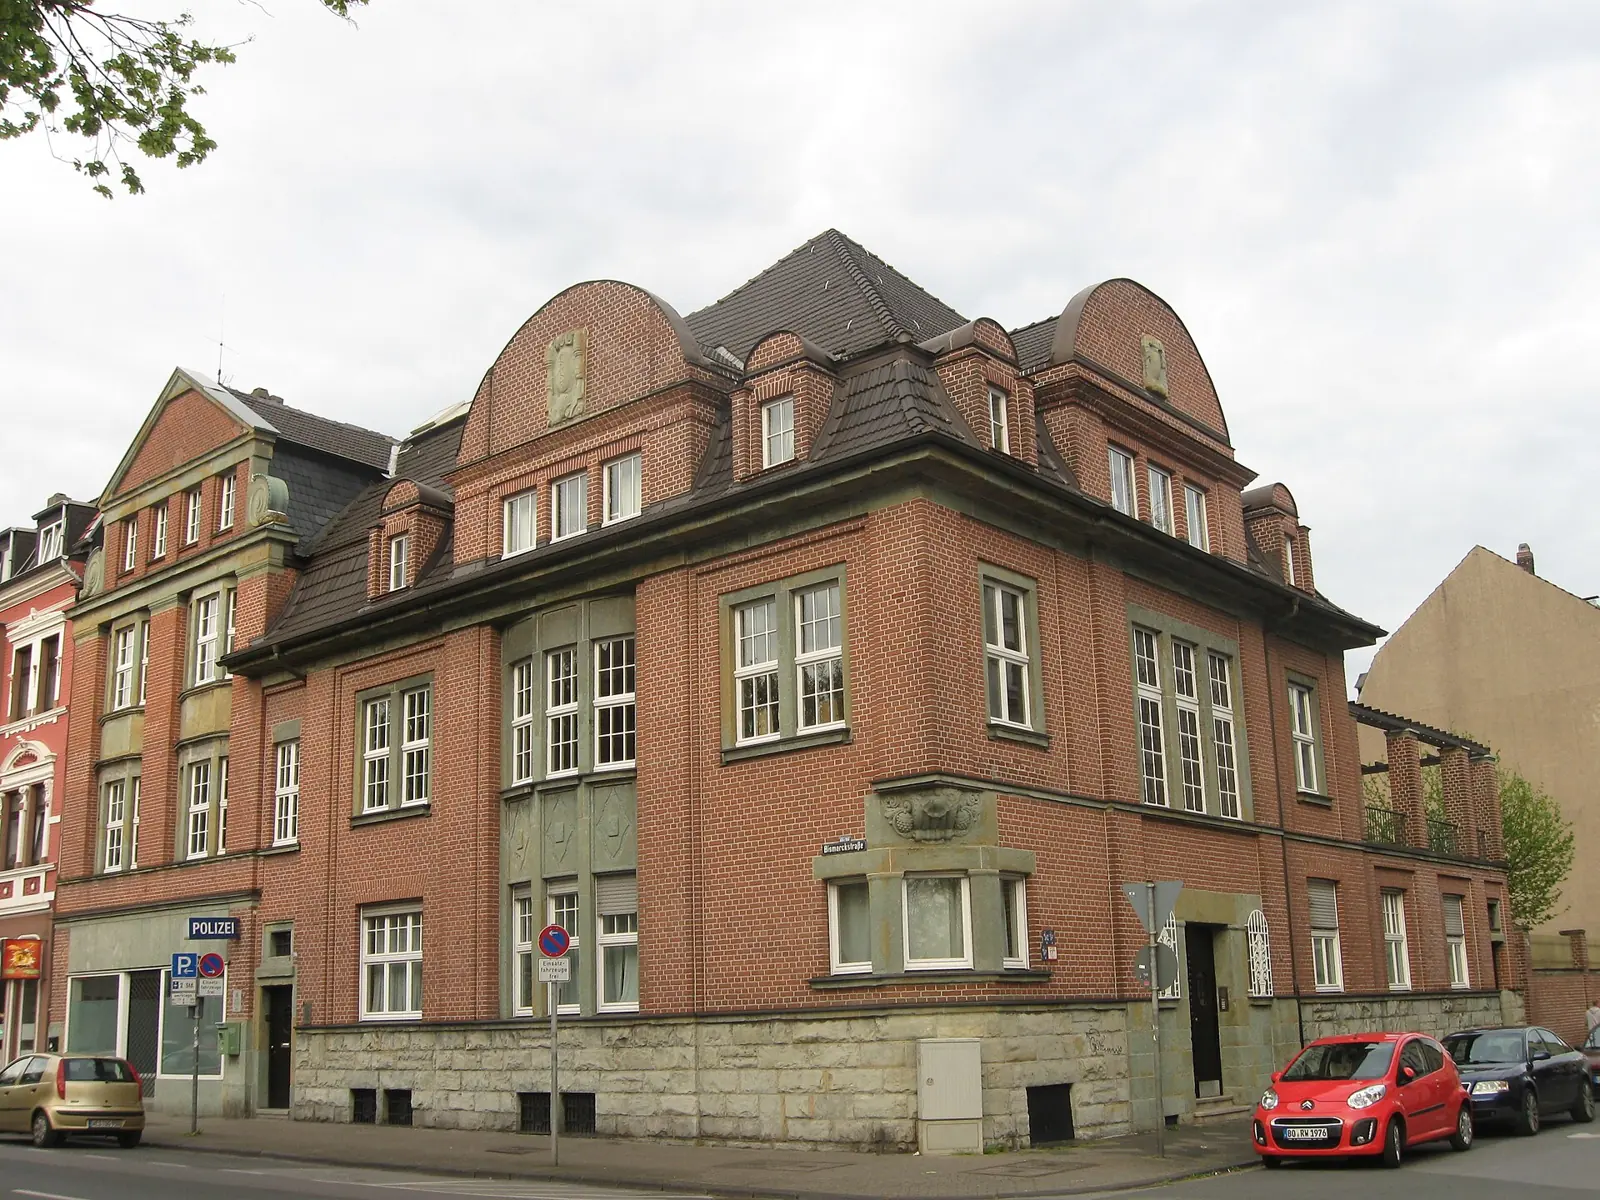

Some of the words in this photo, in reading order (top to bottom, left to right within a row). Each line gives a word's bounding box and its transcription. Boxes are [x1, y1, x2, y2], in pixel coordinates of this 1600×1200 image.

[823, 841, 864, 853] Bismarckstraße
[192, 922, 234, 935] POLIZEI
[177, 956, 191, 975] P
[1287, 1129, 1296, 1138] BO
[1300, 1129, 1309, 1137] RW
[1310, 1129, 1327, 1137] 1976
